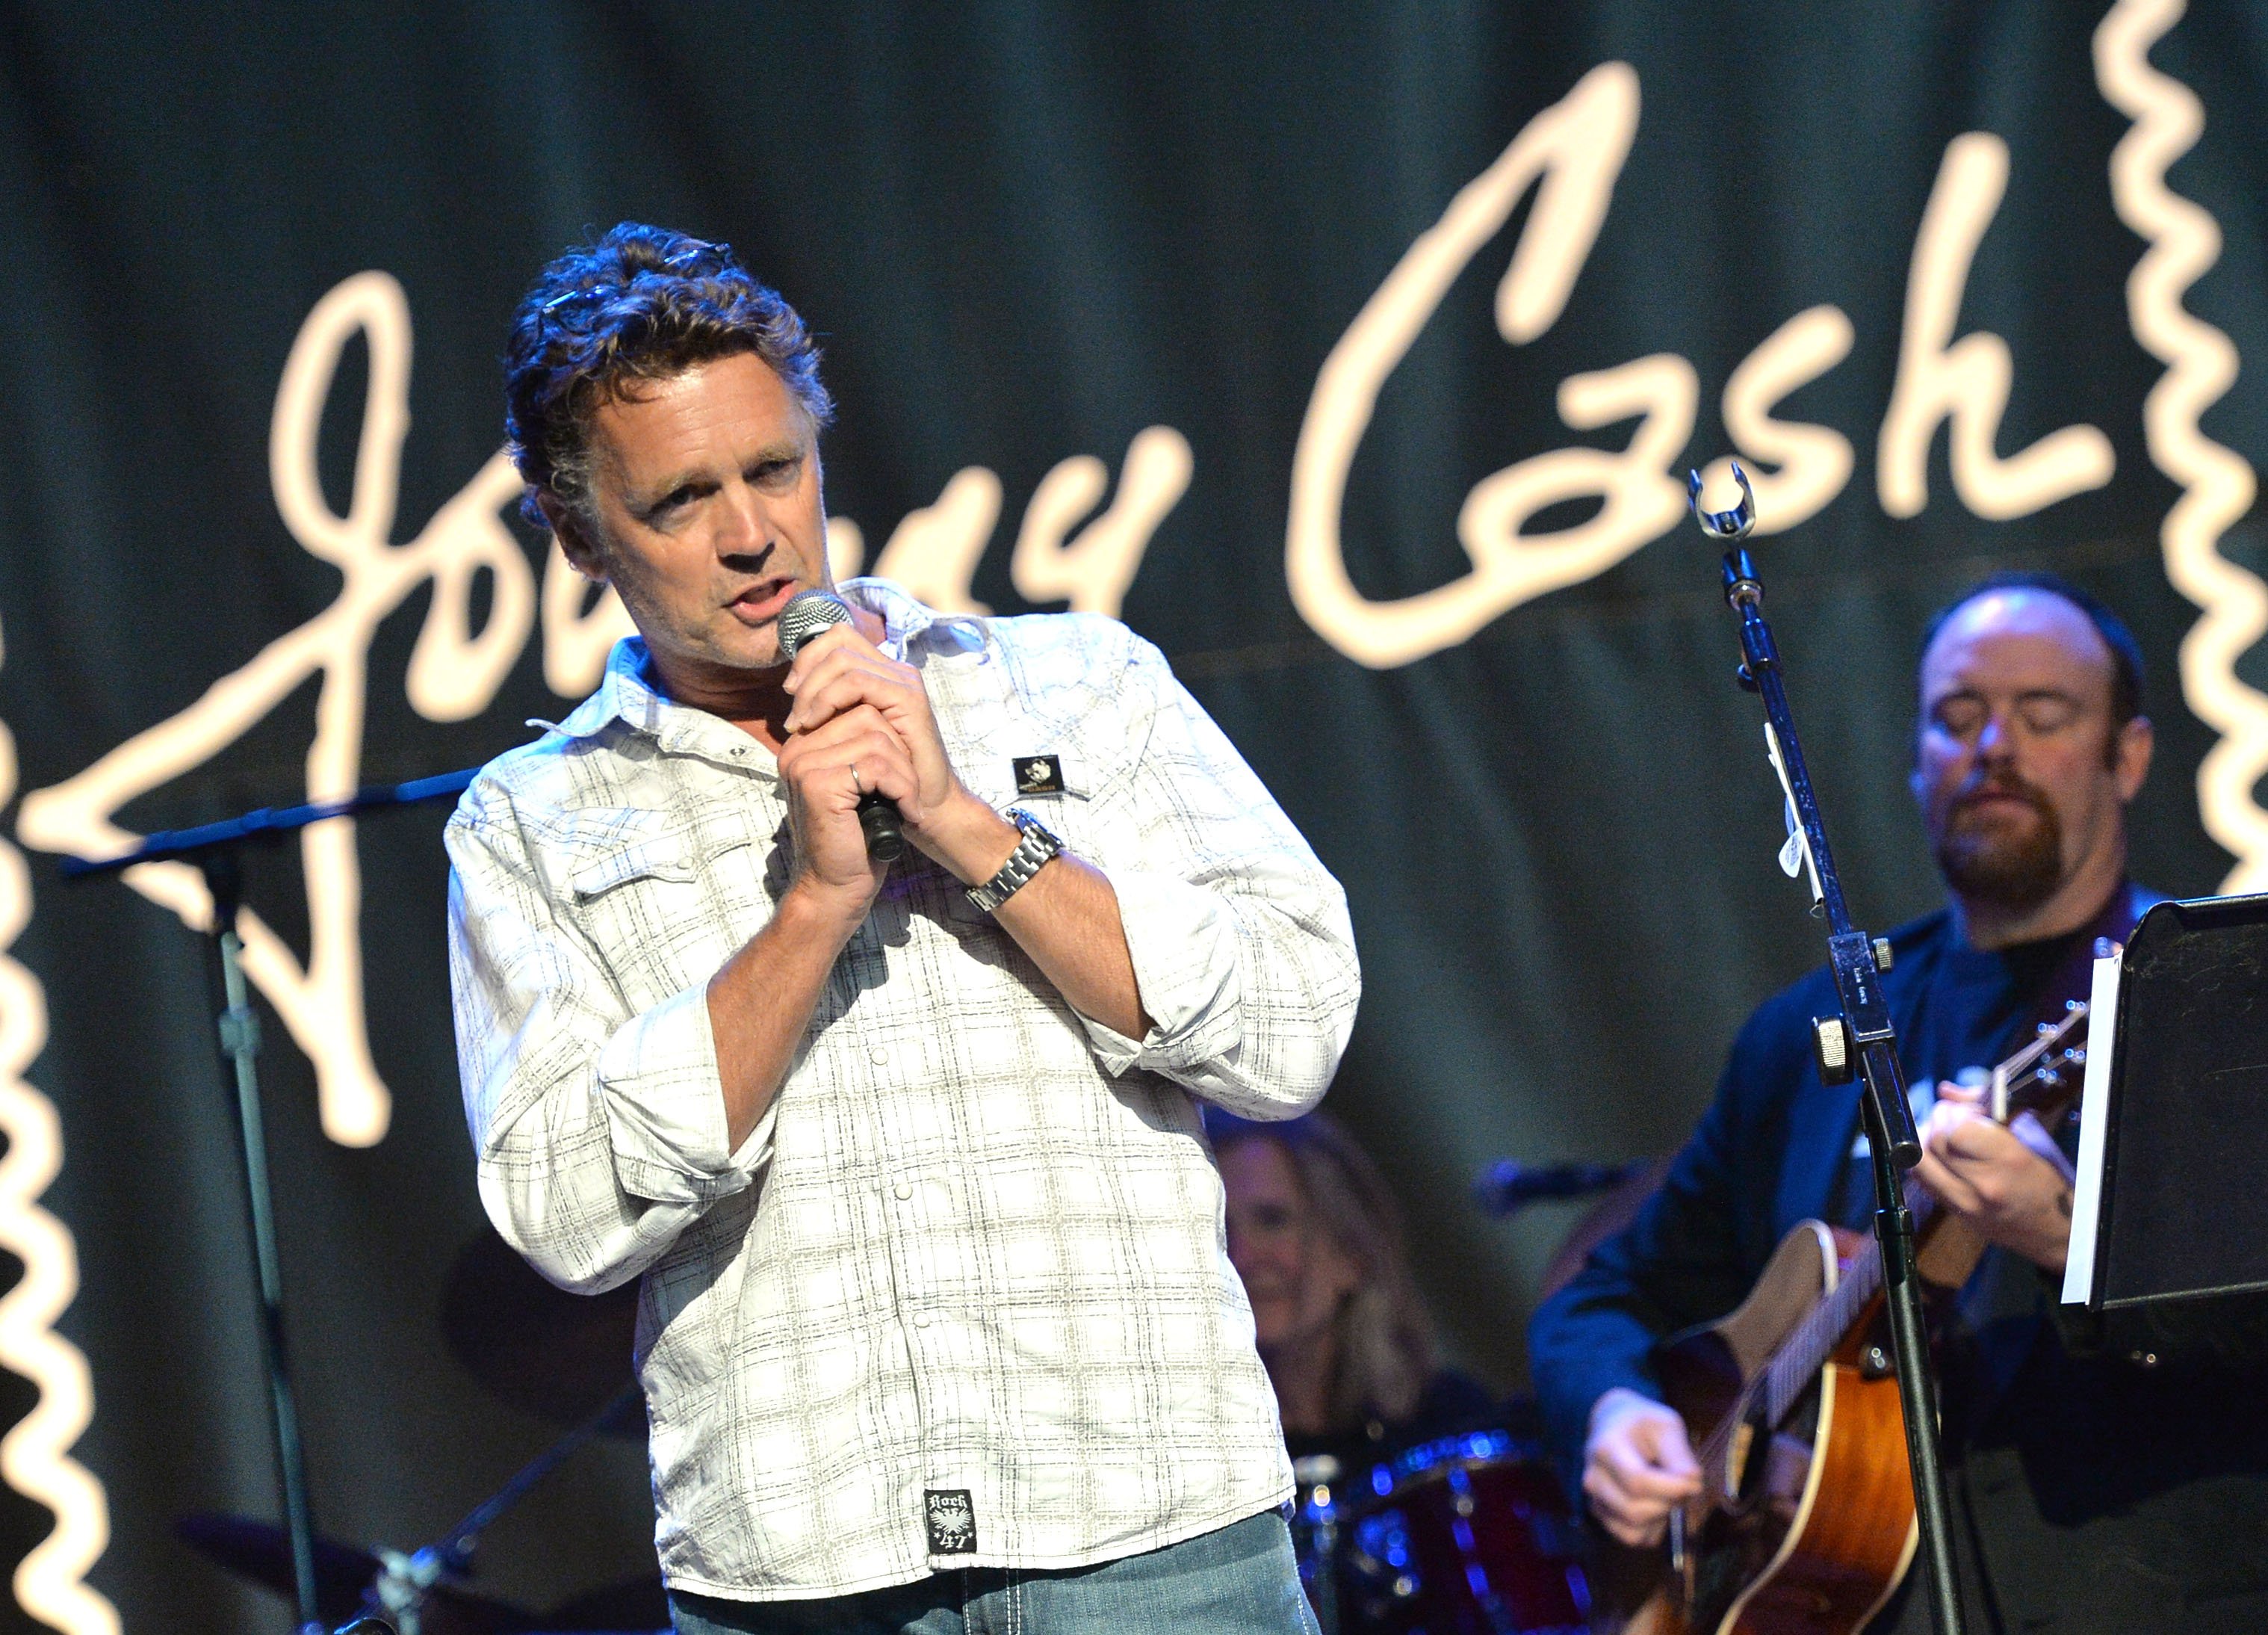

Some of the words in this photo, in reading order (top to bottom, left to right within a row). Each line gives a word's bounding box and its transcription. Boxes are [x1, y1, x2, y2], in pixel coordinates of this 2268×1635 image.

[1286, 60, 2116, 668] Cash
[929, 1495, 968, 1509] Rock
[939, 1534, 967, 1549] 47
